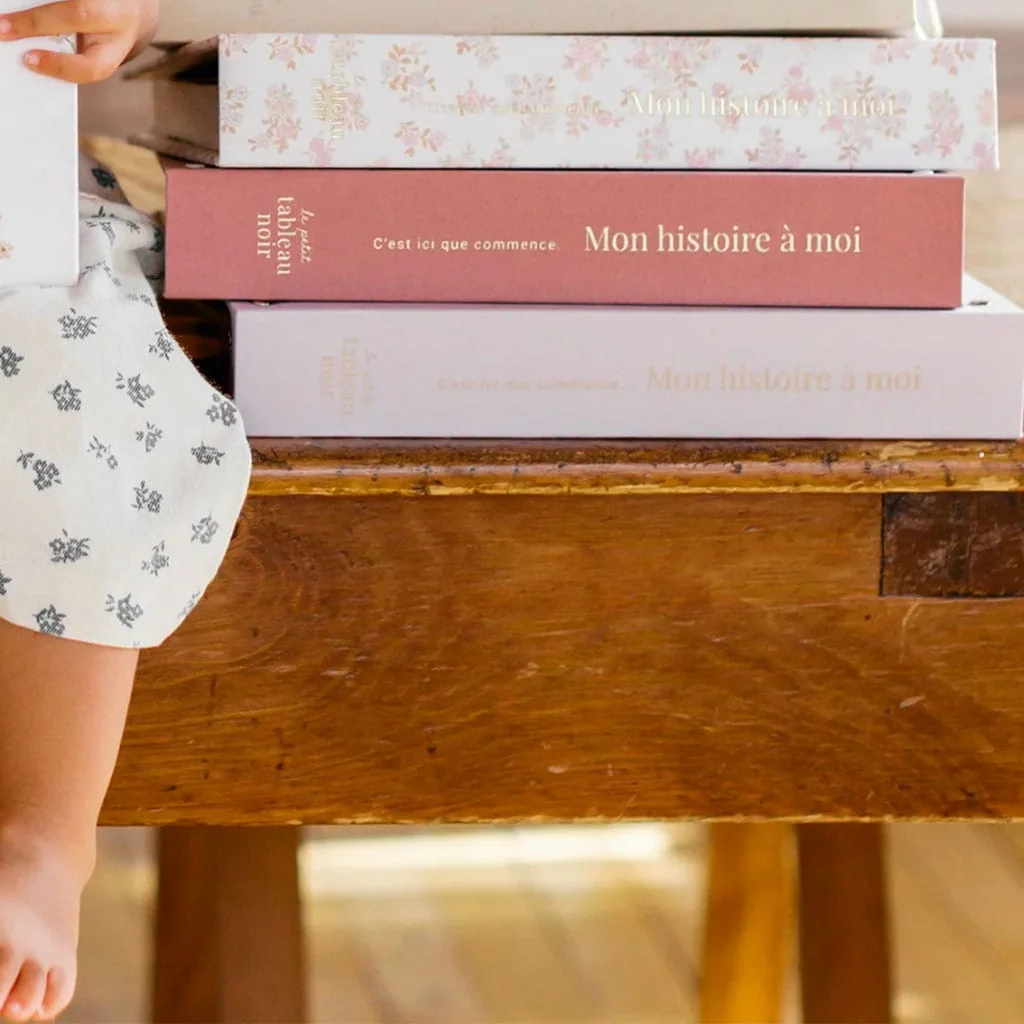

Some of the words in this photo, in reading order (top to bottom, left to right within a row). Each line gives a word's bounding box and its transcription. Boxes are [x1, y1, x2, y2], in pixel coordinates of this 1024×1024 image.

[629, 91, 691, 117] Mon
[257, 213, 276, 259] noir
[277, 196, 296, 276] tableau
[373, 236, 412, 251] C'est
[417, 236, 436, 251] ici
[440, 239, 469, 254] que
[584, 226, 648, 252] Mon
[657, 224, 770, 253] histoire
[779, 224, 796, 252] à
[804, 225, 862, 253] moi
[646, 364, 710, 392] Mon
[719, 363, 829, 392] histoire
[840, 363, 856, 392] à
[865, 365, 922, 392] moi
